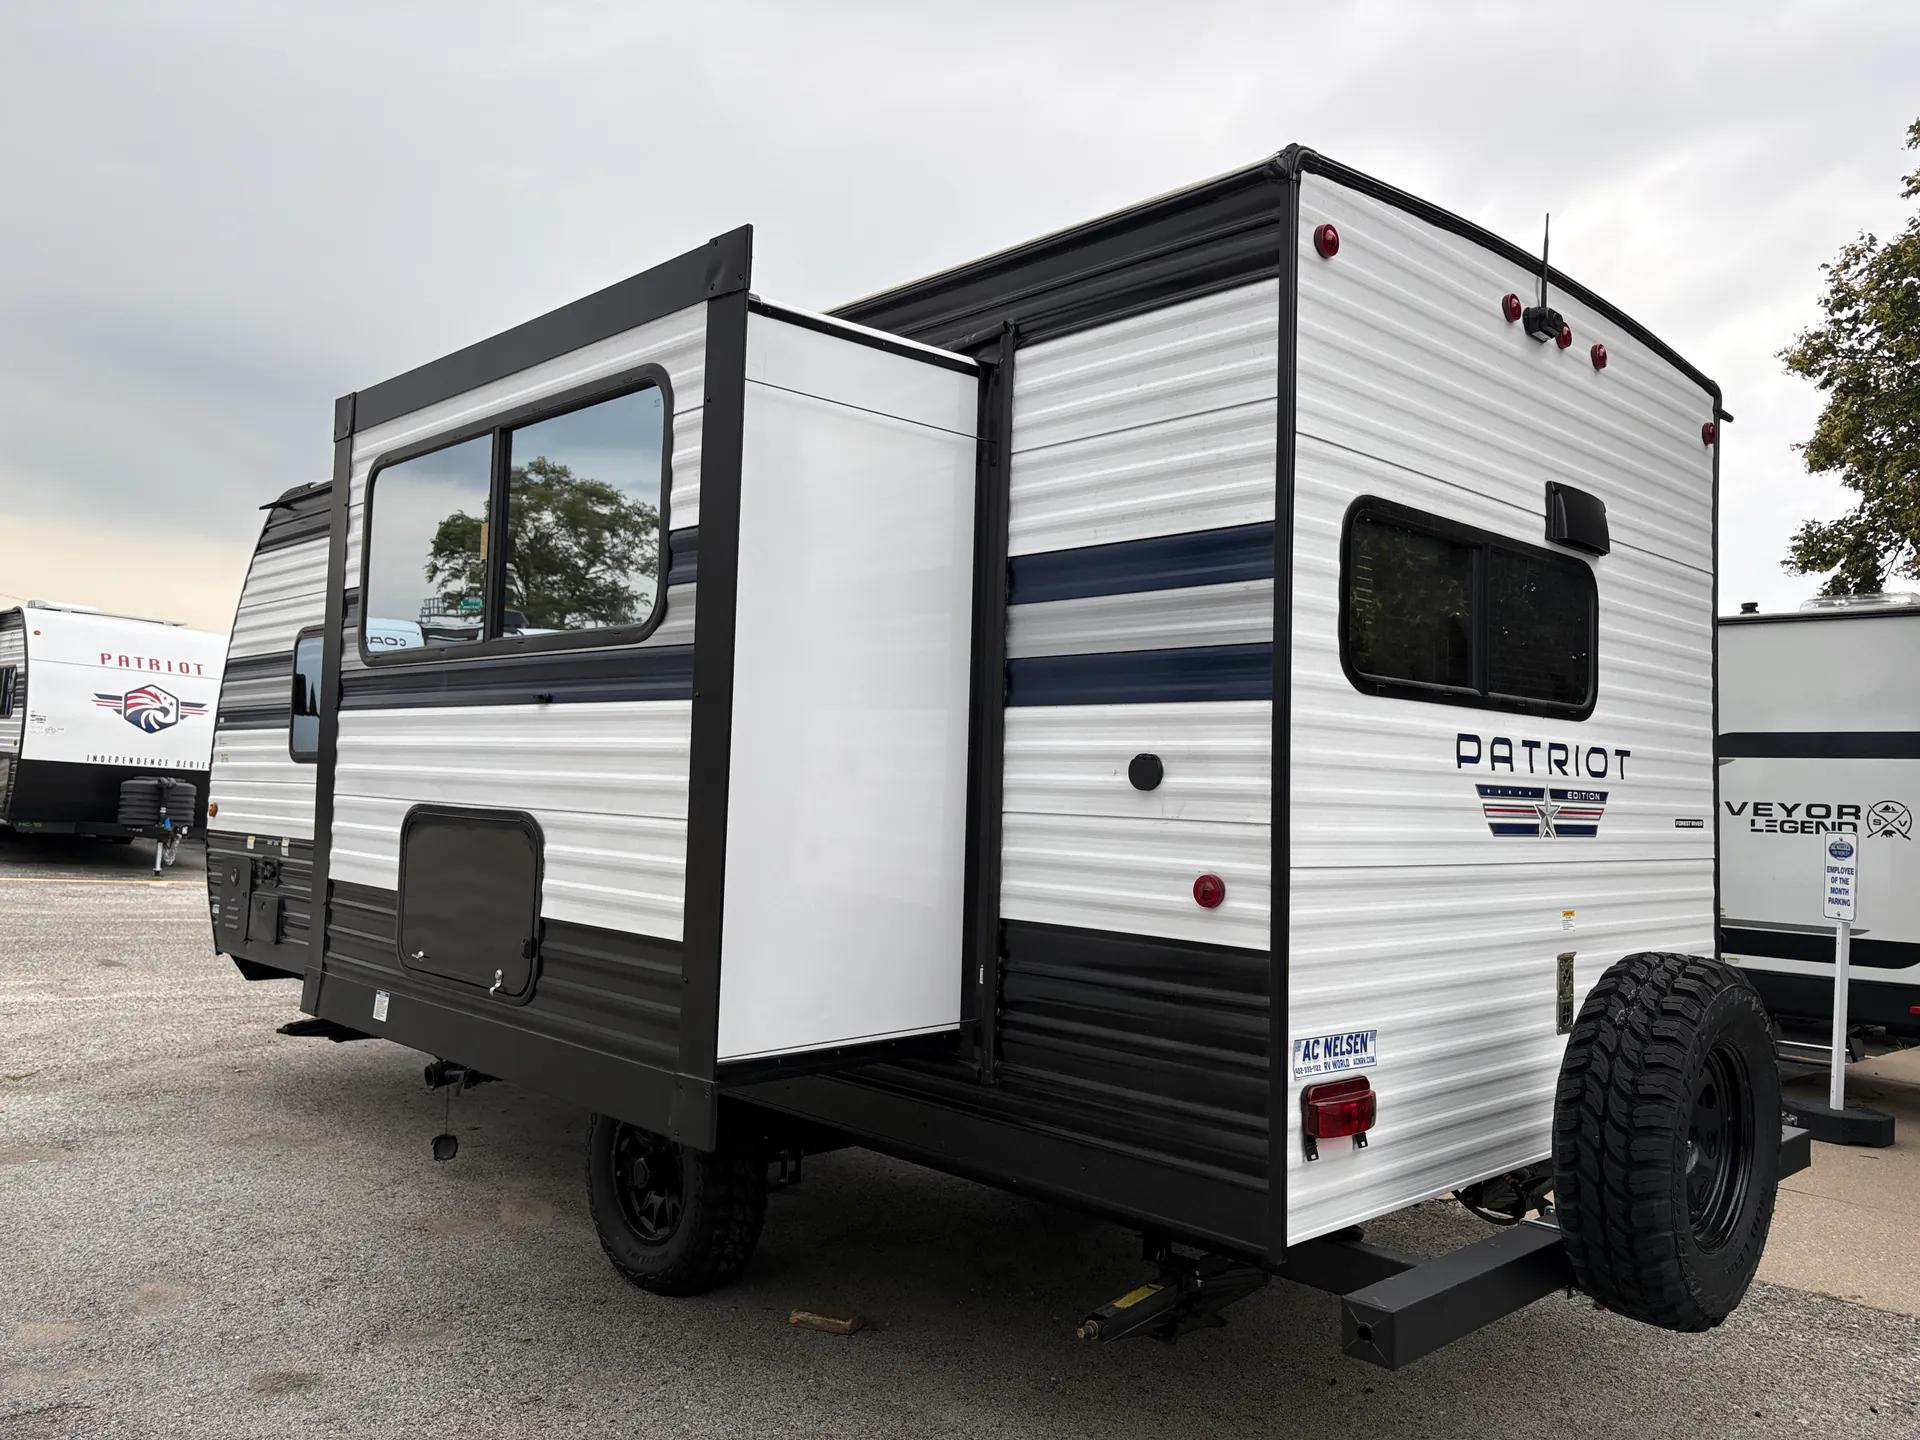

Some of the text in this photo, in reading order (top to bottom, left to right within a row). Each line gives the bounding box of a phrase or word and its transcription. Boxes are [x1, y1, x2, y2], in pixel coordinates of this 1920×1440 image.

[100, 652, 205, 676] PATRIOT
[86, 754, 168, 767] INDEPENDENCE
[1456, 732, 1631, 780] PATRIOT
[1567, 790, 1600, 801] EDITION
[1750, 818, 1858, 835] LEGEND
[1826, 865, 1855, 876] EMPLOYEE
[1830, 876, 1850, 886] OF THE
[1830, 886, 1850, 896] MONTH
[1828, 897, 1850, 906] PARKING
[1302, 1033, 1368, 1061] AC NELSEN
[1324, 1059, 1349, 1071] RV WORLD
